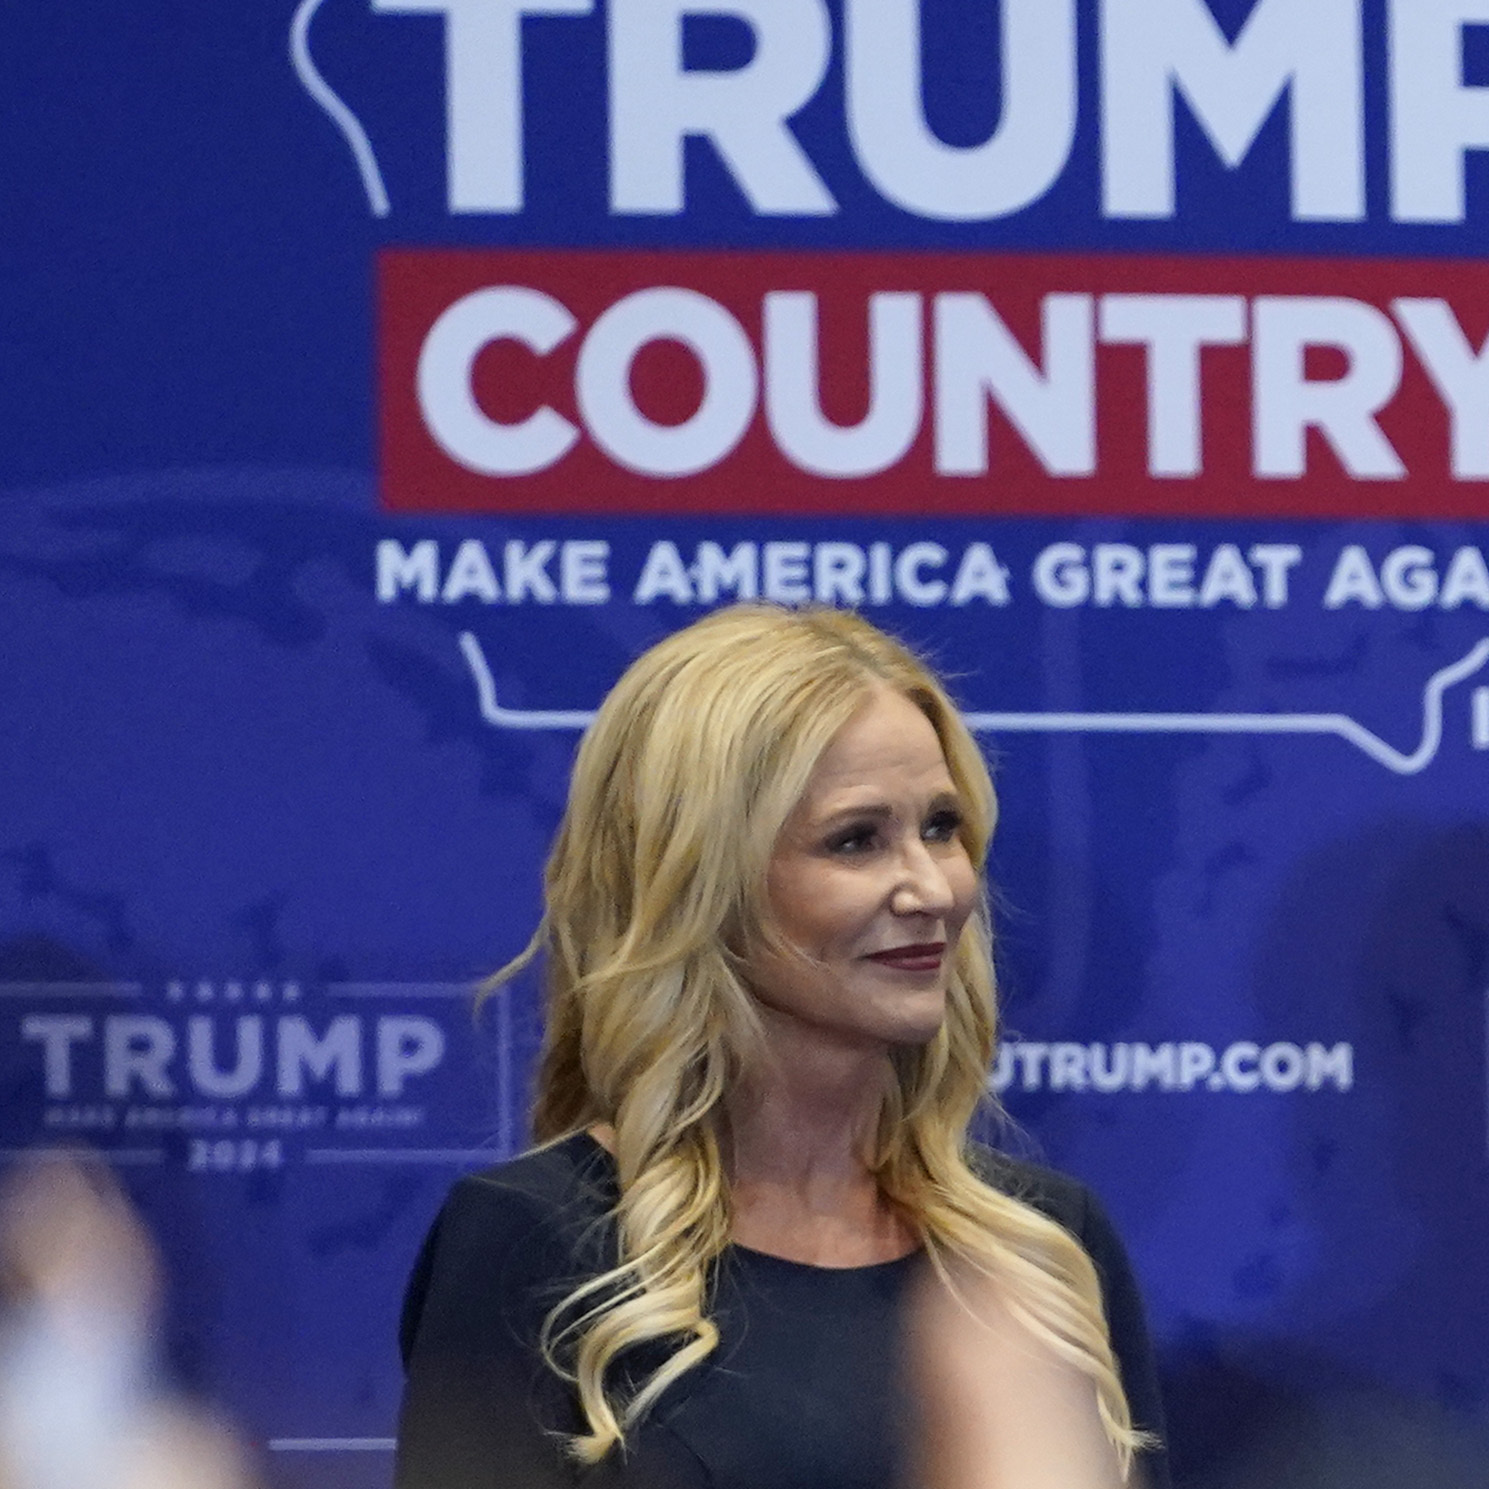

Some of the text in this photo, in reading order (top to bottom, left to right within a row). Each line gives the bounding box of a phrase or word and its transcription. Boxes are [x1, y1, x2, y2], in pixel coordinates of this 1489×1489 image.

[374, 538, 611, 604] MAKE
[634, 540, 1012, 607] AMERICA
[1032, 541, 1303, 609] GREAT
[20, 1013, 447, 1098] TRUMP
[986, 1041, 1356, 1092] JTRUMP.COM
